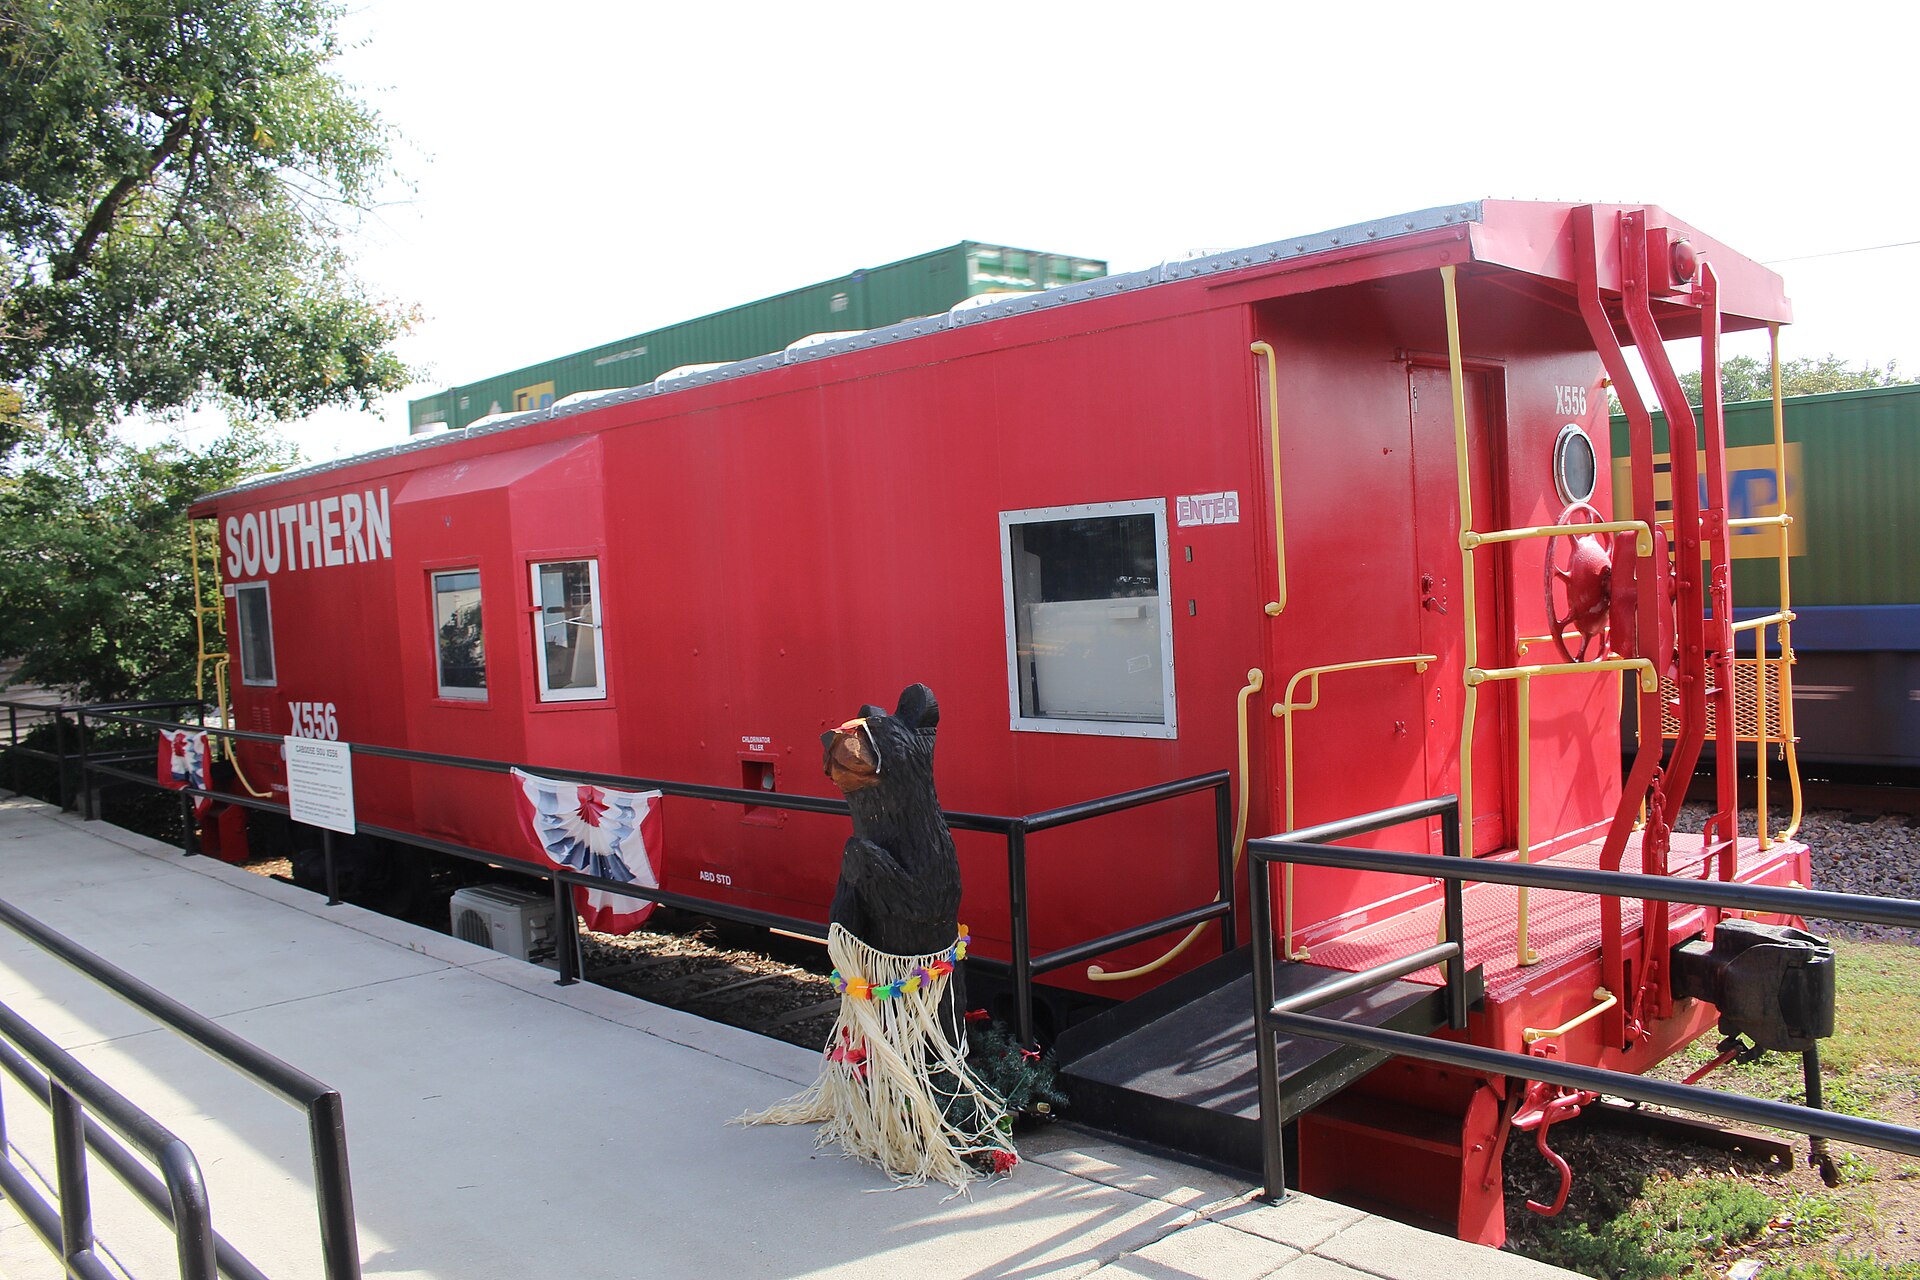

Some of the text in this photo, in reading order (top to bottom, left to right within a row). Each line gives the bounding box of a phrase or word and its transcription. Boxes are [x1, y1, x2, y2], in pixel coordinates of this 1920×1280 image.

[1554, 385, 1587, 416] X556
[1178, 497, 1238, 521] ENTER
[225, 487, 392, 578] SOUTHERN
[288, 701, 339, 741] X556
[749, 743, 764, 751] FILLER
[715, 873, 732, 885] STD
